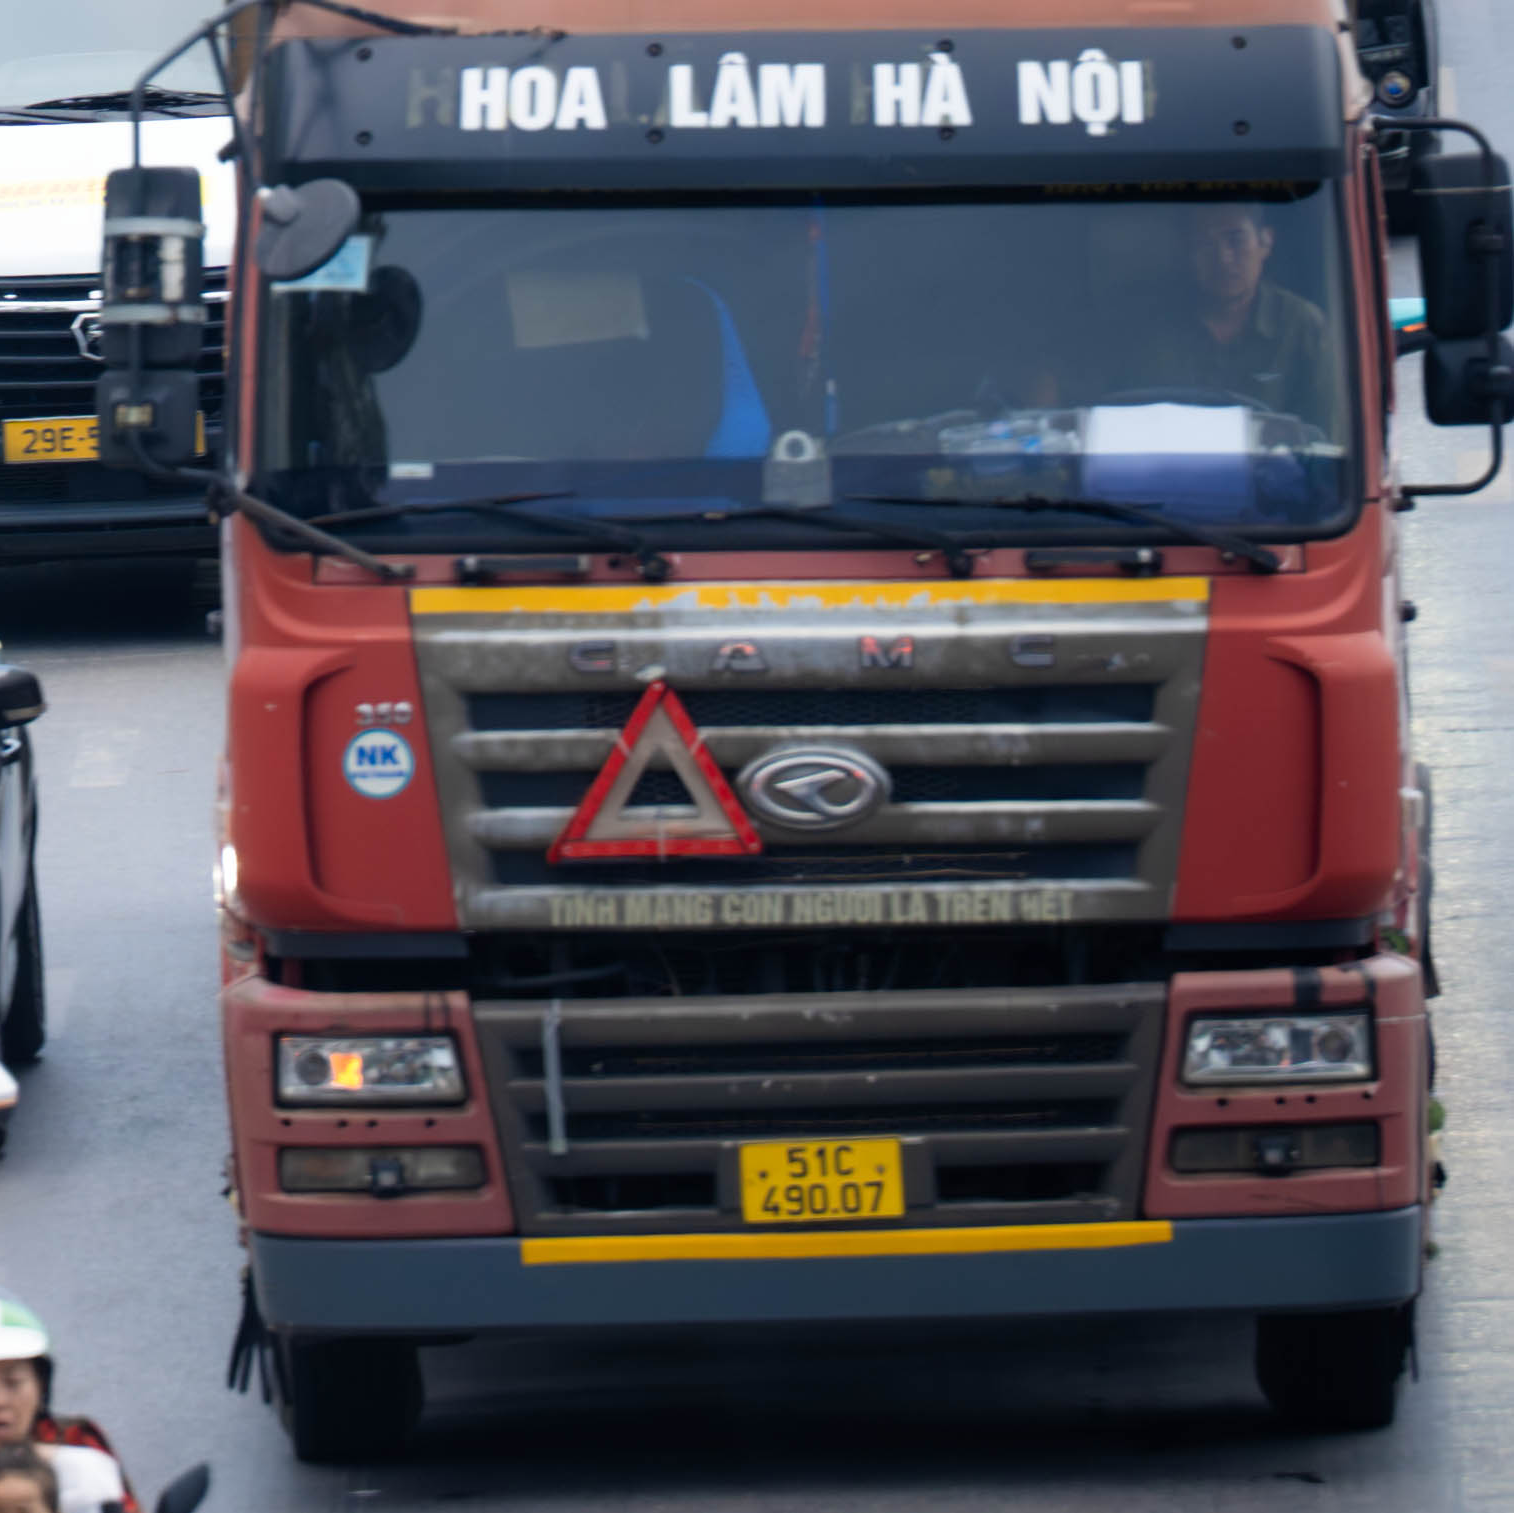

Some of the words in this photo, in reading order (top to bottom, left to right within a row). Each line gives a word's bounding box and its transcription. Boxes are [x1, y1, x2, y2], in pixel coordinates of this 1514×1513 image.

[460, 66, 608, 131] HOA
[669, 52, 826, 129] LÂM
[873, 51, 973, 128] HÀ
[1016, 48, 1145, 137] NỘI
[357, 745, 400, 767] NK
[787, 1145, 854, 1179] 51C
[762, 1180, 884, 1216] 490.07
